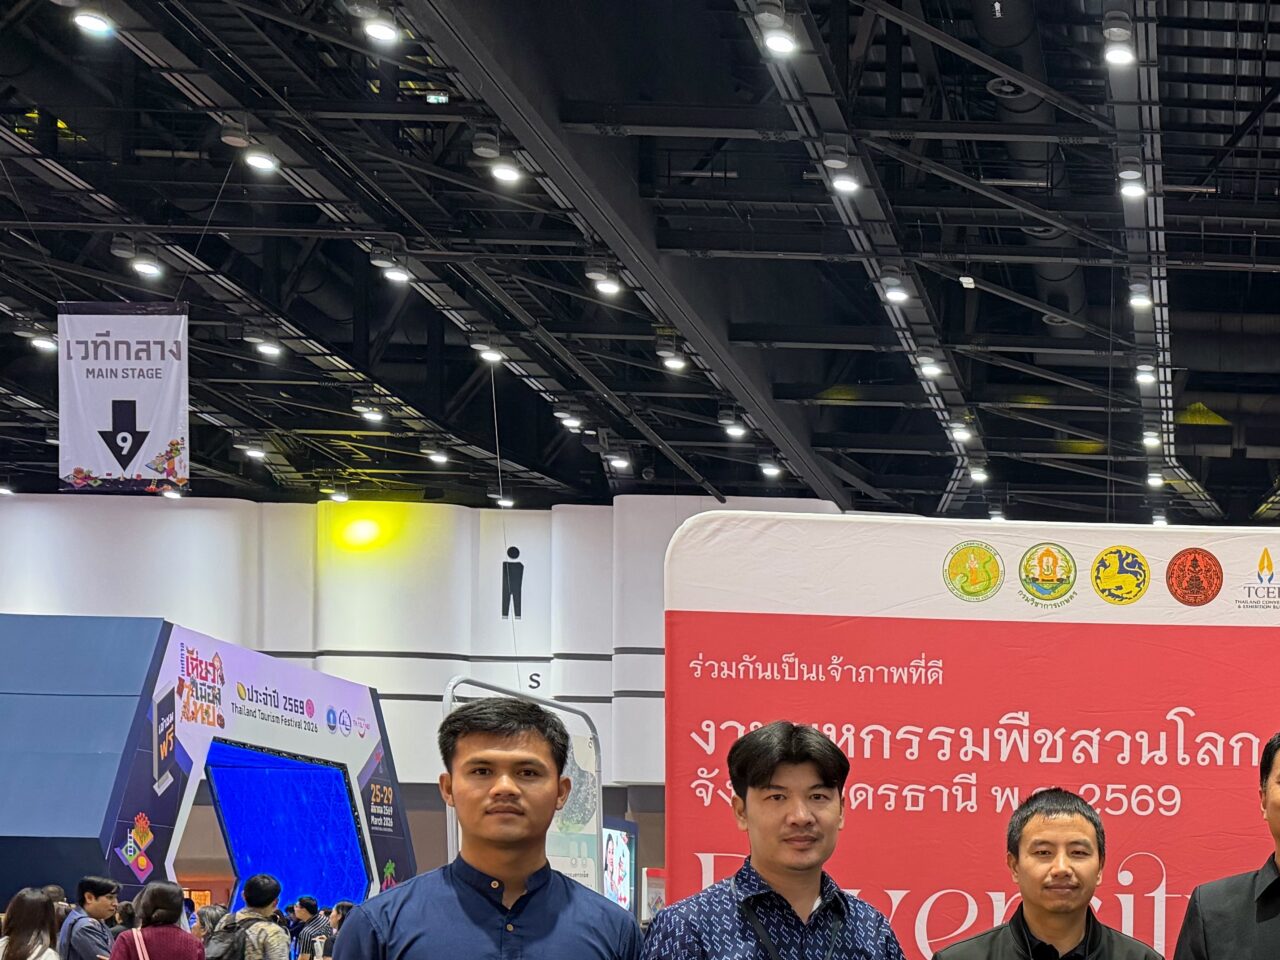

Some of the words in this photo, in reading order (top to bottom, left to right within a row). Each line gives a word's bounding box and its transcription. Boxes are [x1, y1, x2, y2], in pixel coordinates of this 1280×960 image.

[66, 330, 182, 361] เวทีกลาง
[86, 368, 118, 379] MAIN
[121, 368, 162, 379] STAGE
[116, 431, 133, 455] 9
[529, 672, 541, 689] S
[689, 652, 943, 685] ร่วมกันเป็นเจ้าภาพที่ดี
[247, 685, 279, 708] ประจำปี
[283, 696, 304, 715] 2569
[231, 703, 256, 718] Thailand
[258, 709, 280, 724] Tourism
[281, 715, 303, 729] Festival
[304, 720, 319, 733] 2026
